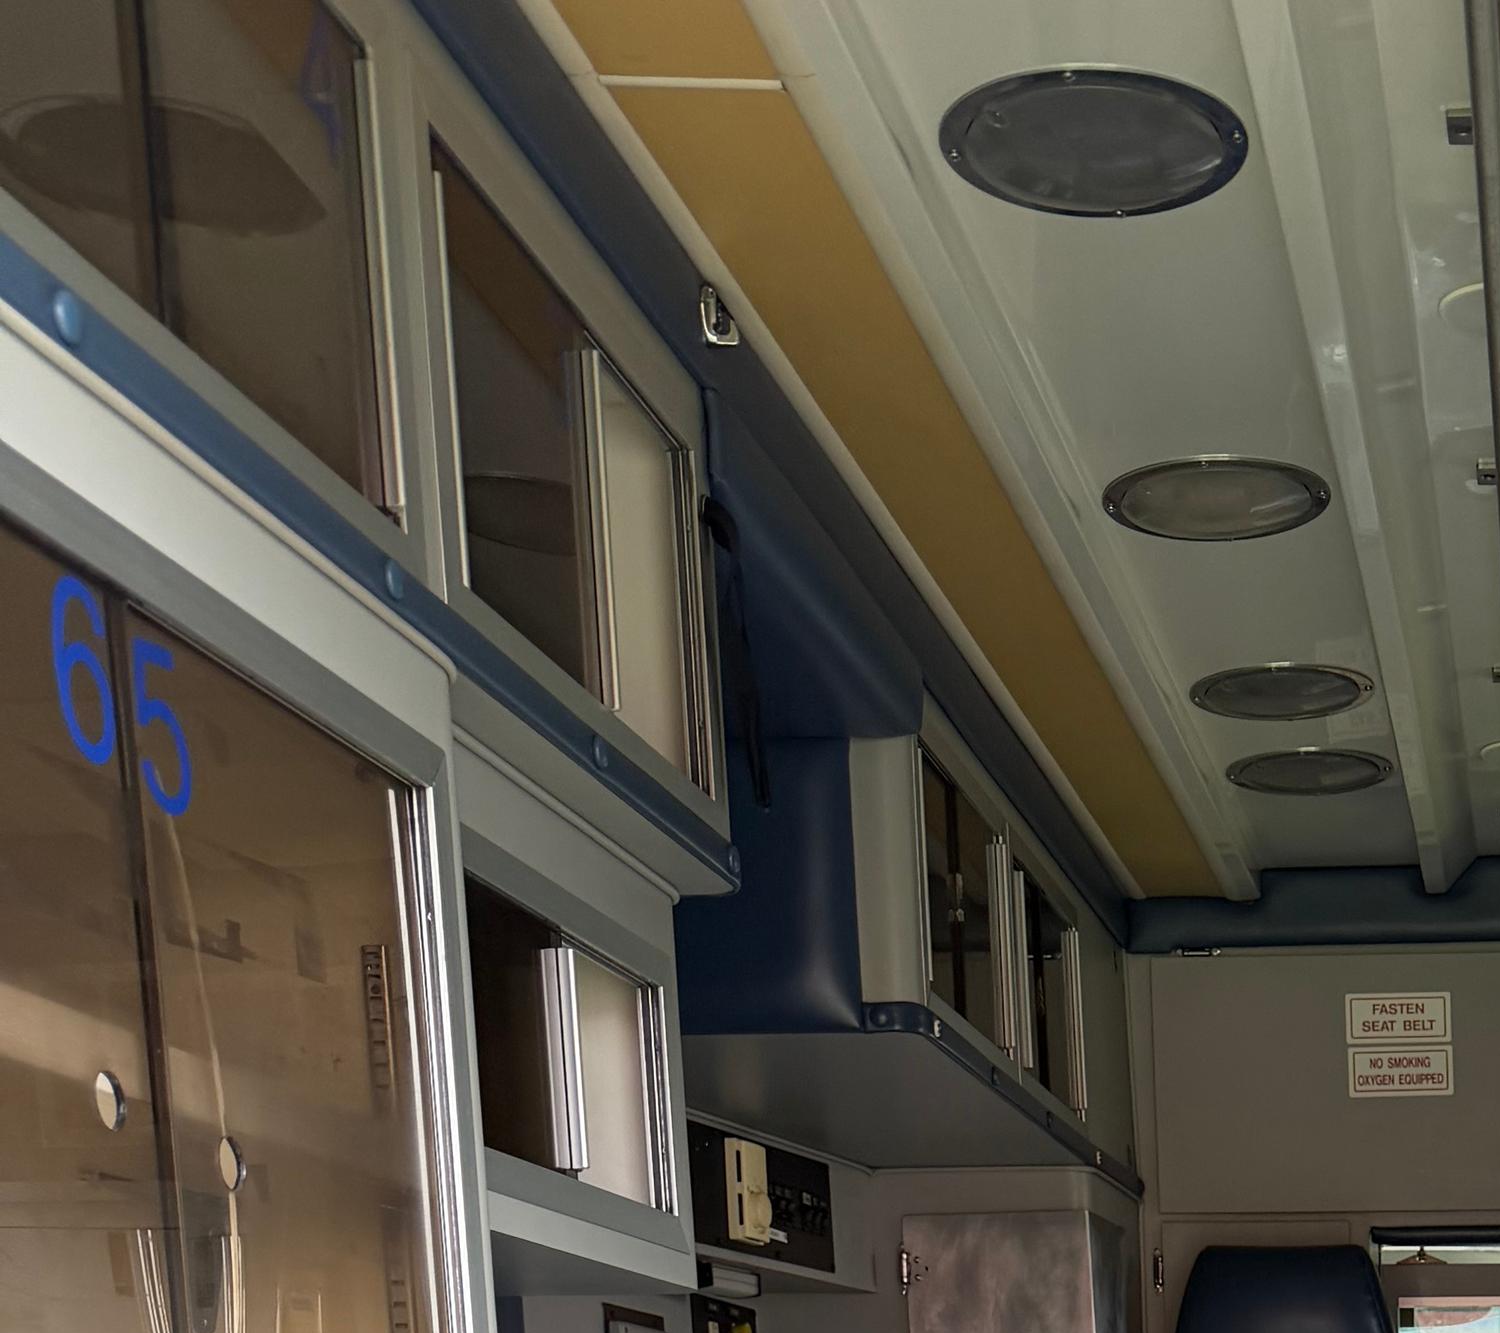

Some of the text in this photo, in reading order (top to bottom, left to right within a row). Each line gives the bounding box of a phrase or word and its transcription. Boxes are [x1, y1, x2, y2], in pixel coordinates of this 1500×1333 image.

[51, 576, 117, 766] 6
[131, 637, 192, 816] 5
[1372, 1003, 1425, 1015] FASTEN
[1362, 1019, 1436, 1032] SEAT BELT
[1369, 1056, 1431, 1069] NO SMOKING
[1357, 1073, 1444, 1086] OXYGEN EQUIPPED
